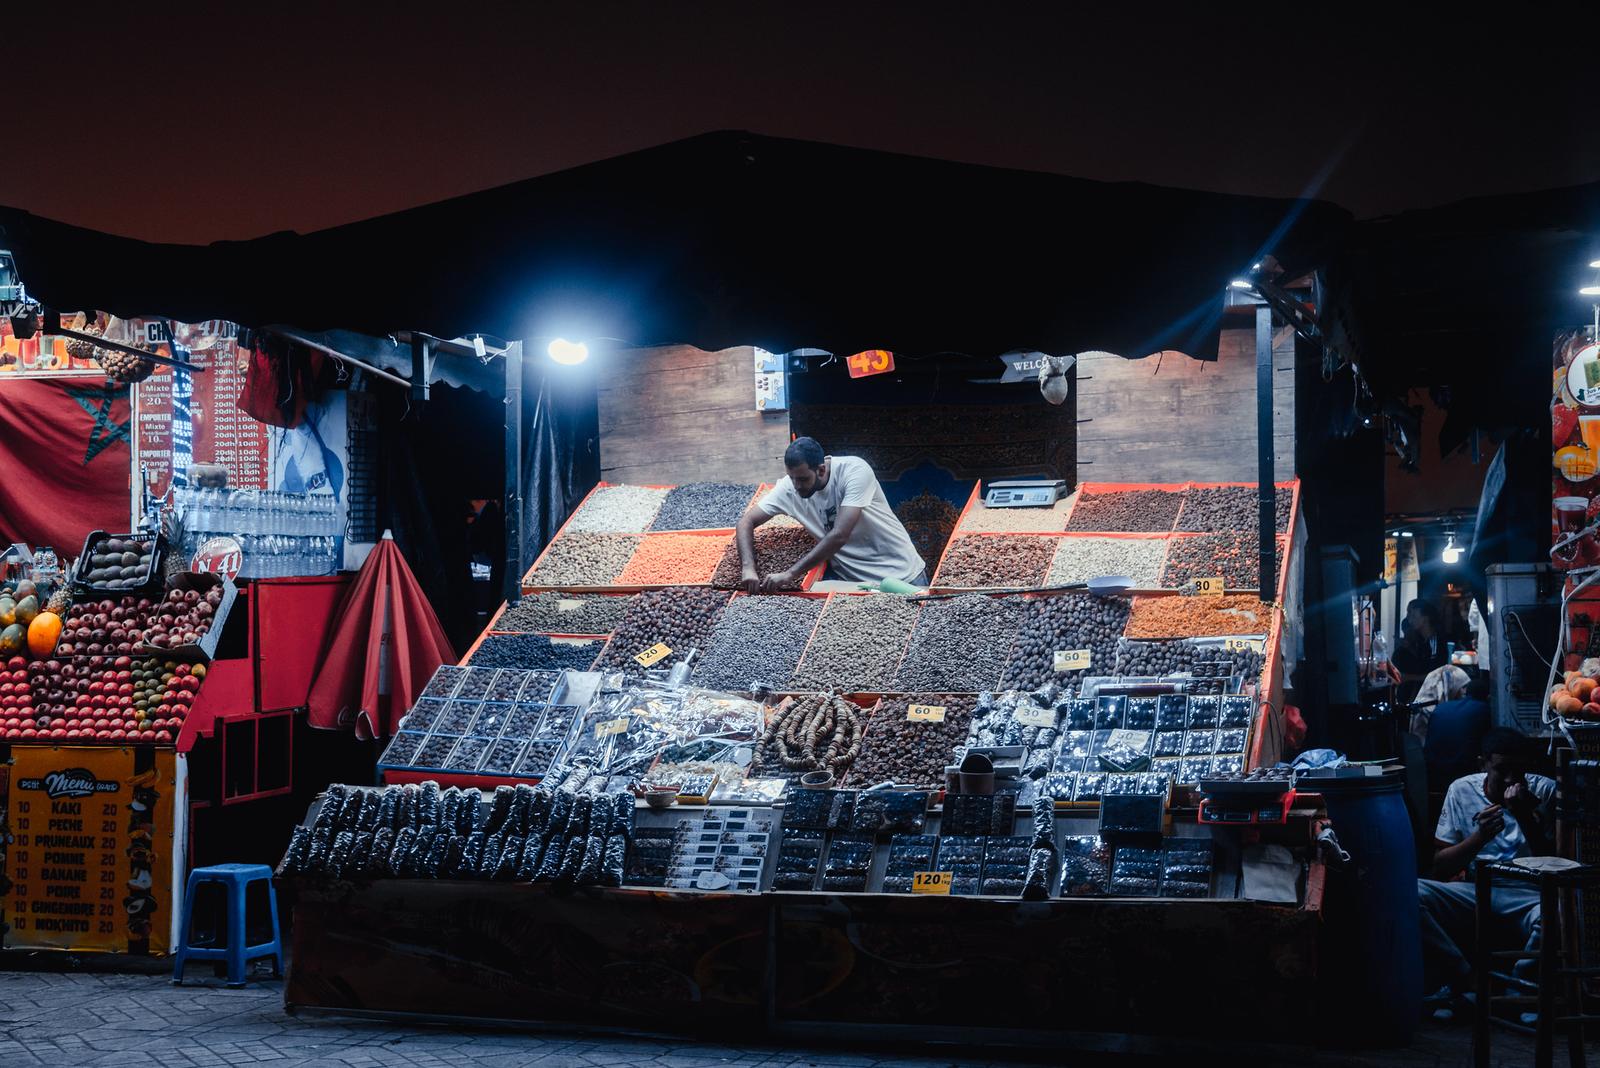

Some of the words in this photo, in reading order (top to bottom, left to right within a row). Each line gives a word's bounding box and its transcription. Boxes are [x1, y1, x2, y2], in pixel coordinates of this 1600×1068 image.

[198, 320, 221, 337] 41
[147, 398, 161, 406] 20
[217, 551, 238, 574] 41
[638, 648, 658, 662] 120
[1065, 652, 1079, 662] 60
[915, 706, 930, 715] 60
[46, 773, 95, 793] Menu
[18, 801, 30, 813] 10
[52, 801, 81, 815] KAKI
[103, 804, 117, 817] 20
[17, 818, 29, 830] 10
[102, 821, 117, 834] 20
[17, 835, 29, 847] 10
[35, 836, 95, 849] PRUNEAUX
[102, 837, 116, 850] 20
[16, 852, 28, 864] 10
[101, 854, 115, 867] 20
[16, 868, 28, 881] 10
[41, 868, 87, 882] BANANE
[100, 871, 115, 884] 20
[916, 874, 941, 885] 120
[15, 885, 27, 897] 10
[100, 887, 114, 900] 20
[15, 902, 26, 914] 10
[99, 905, 113, 917] 20
[14, 918, 26, 931] 10
[99, 921, 113, 934] 20
